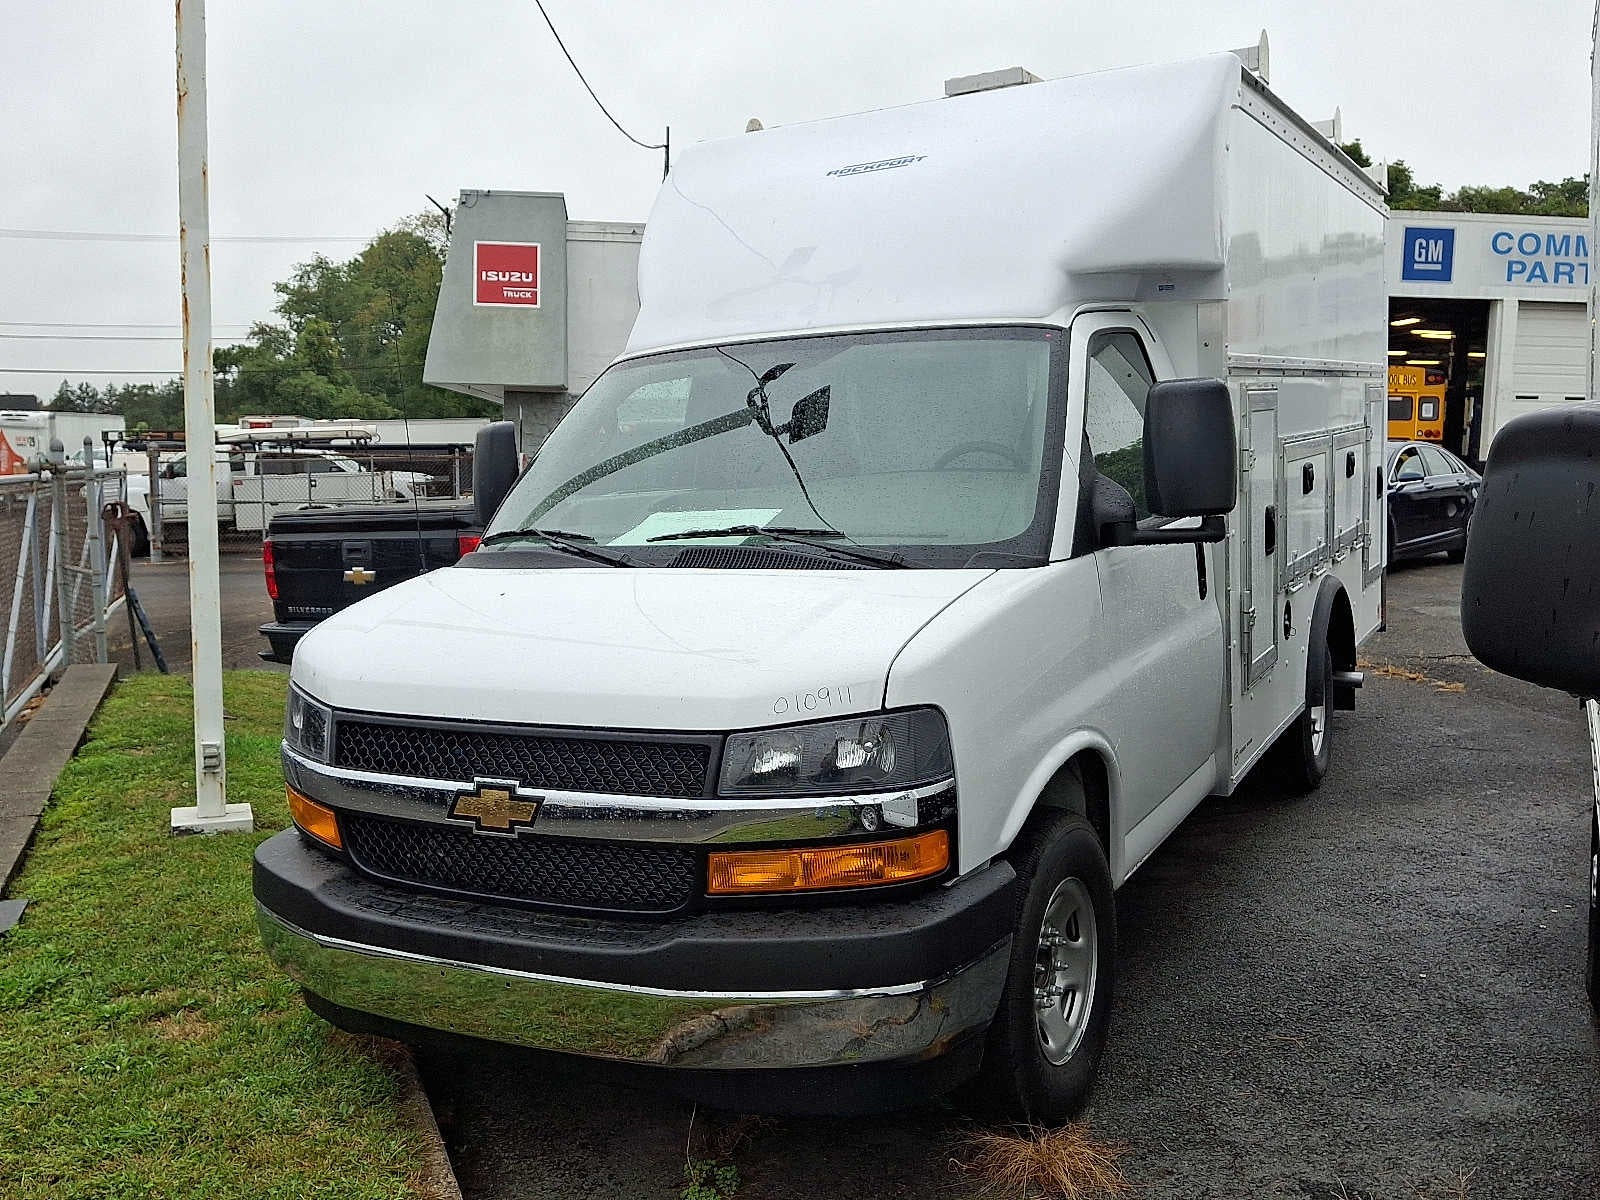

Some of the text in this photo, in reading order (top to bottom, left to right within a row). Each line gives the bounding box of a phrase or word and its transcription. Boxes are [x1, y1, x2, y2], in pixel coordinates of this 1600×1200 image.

[825, 155, 929, 177] ROCKPORT
[1413, 238, 1444, 264] GM
[481, 270, 534, 283] ISUZU
[1506, 259, 1589, 285] PART
[503, 290, 533, 299] TRUCK
[1403, 374, 1417, 386] BUS
[287, 606, 334, 614] SILVERADO
[773, 686, 852, 714] 010911
